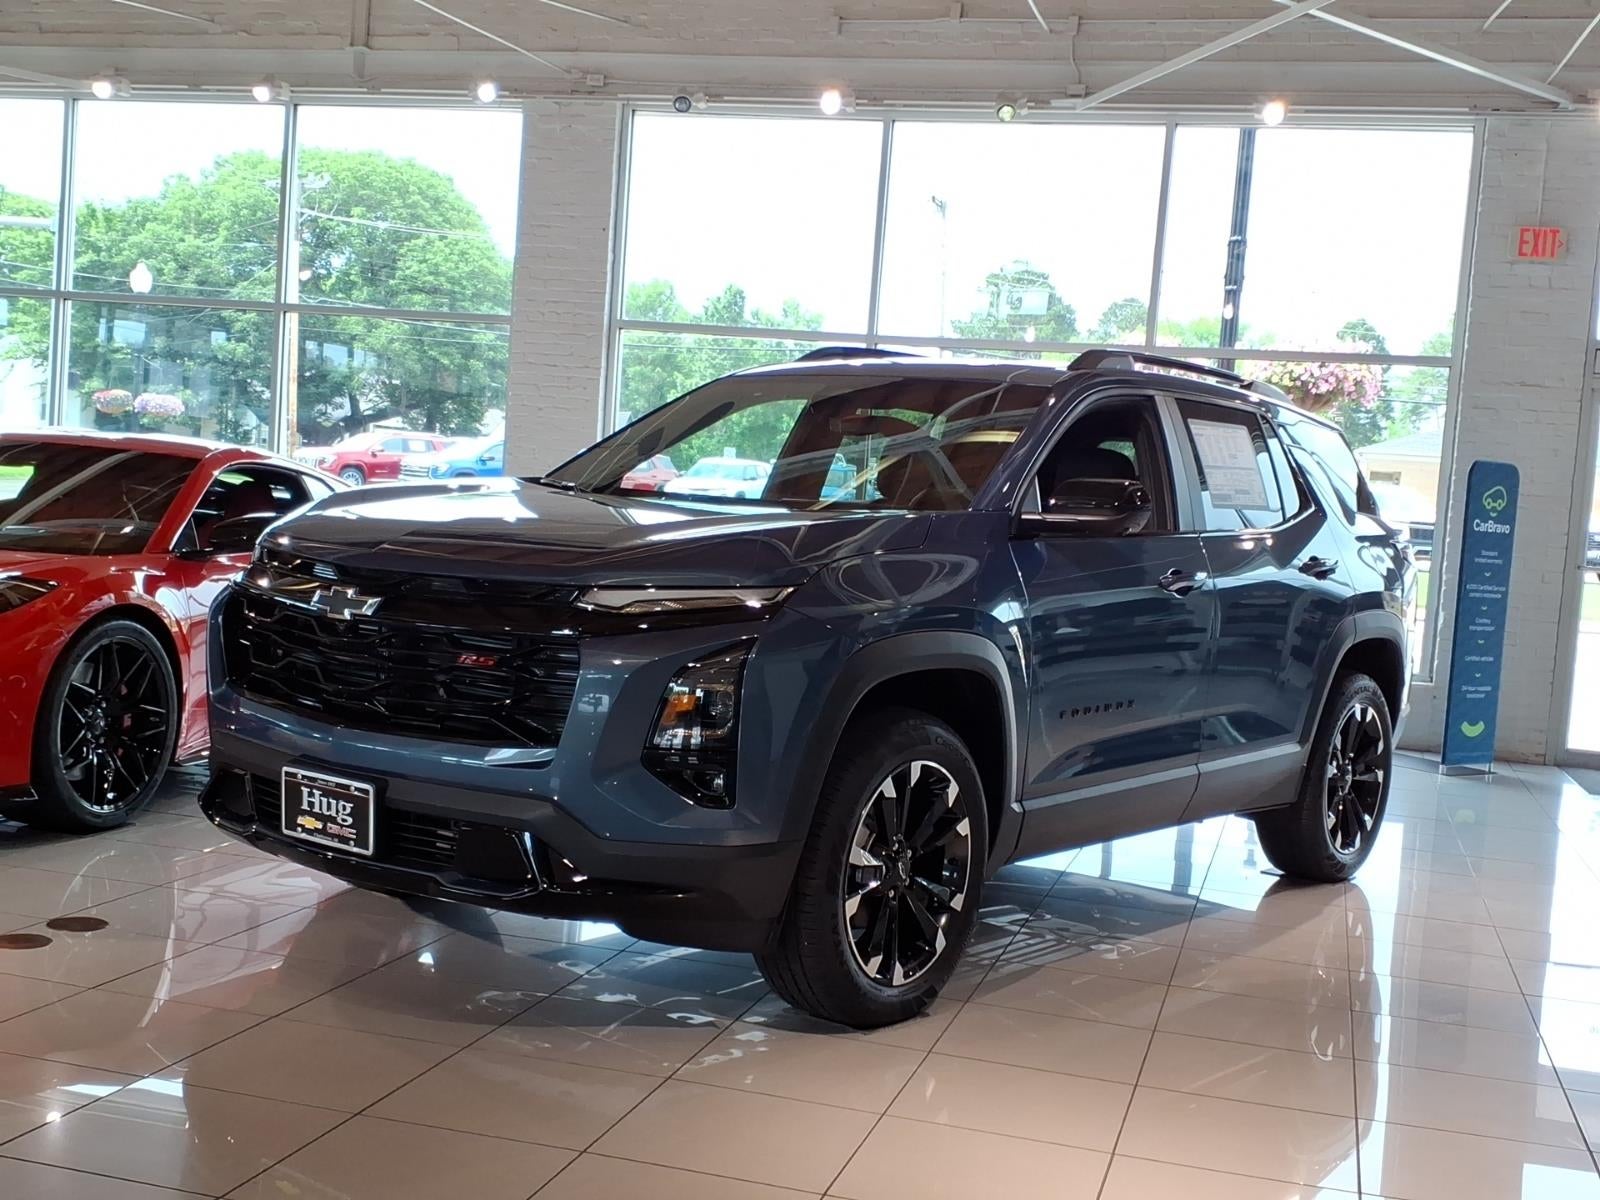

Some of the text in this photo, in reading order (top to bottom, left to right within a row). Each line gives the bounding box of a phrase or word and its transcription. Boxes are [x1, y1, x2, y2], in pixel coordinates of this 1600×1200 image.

[1518, 227, 1561, 257] EXIT
[1473, 518, 1511, 534] CarBravo
[457, 655, 496, 667] RS
[301, 786, 354, 826] Hug
